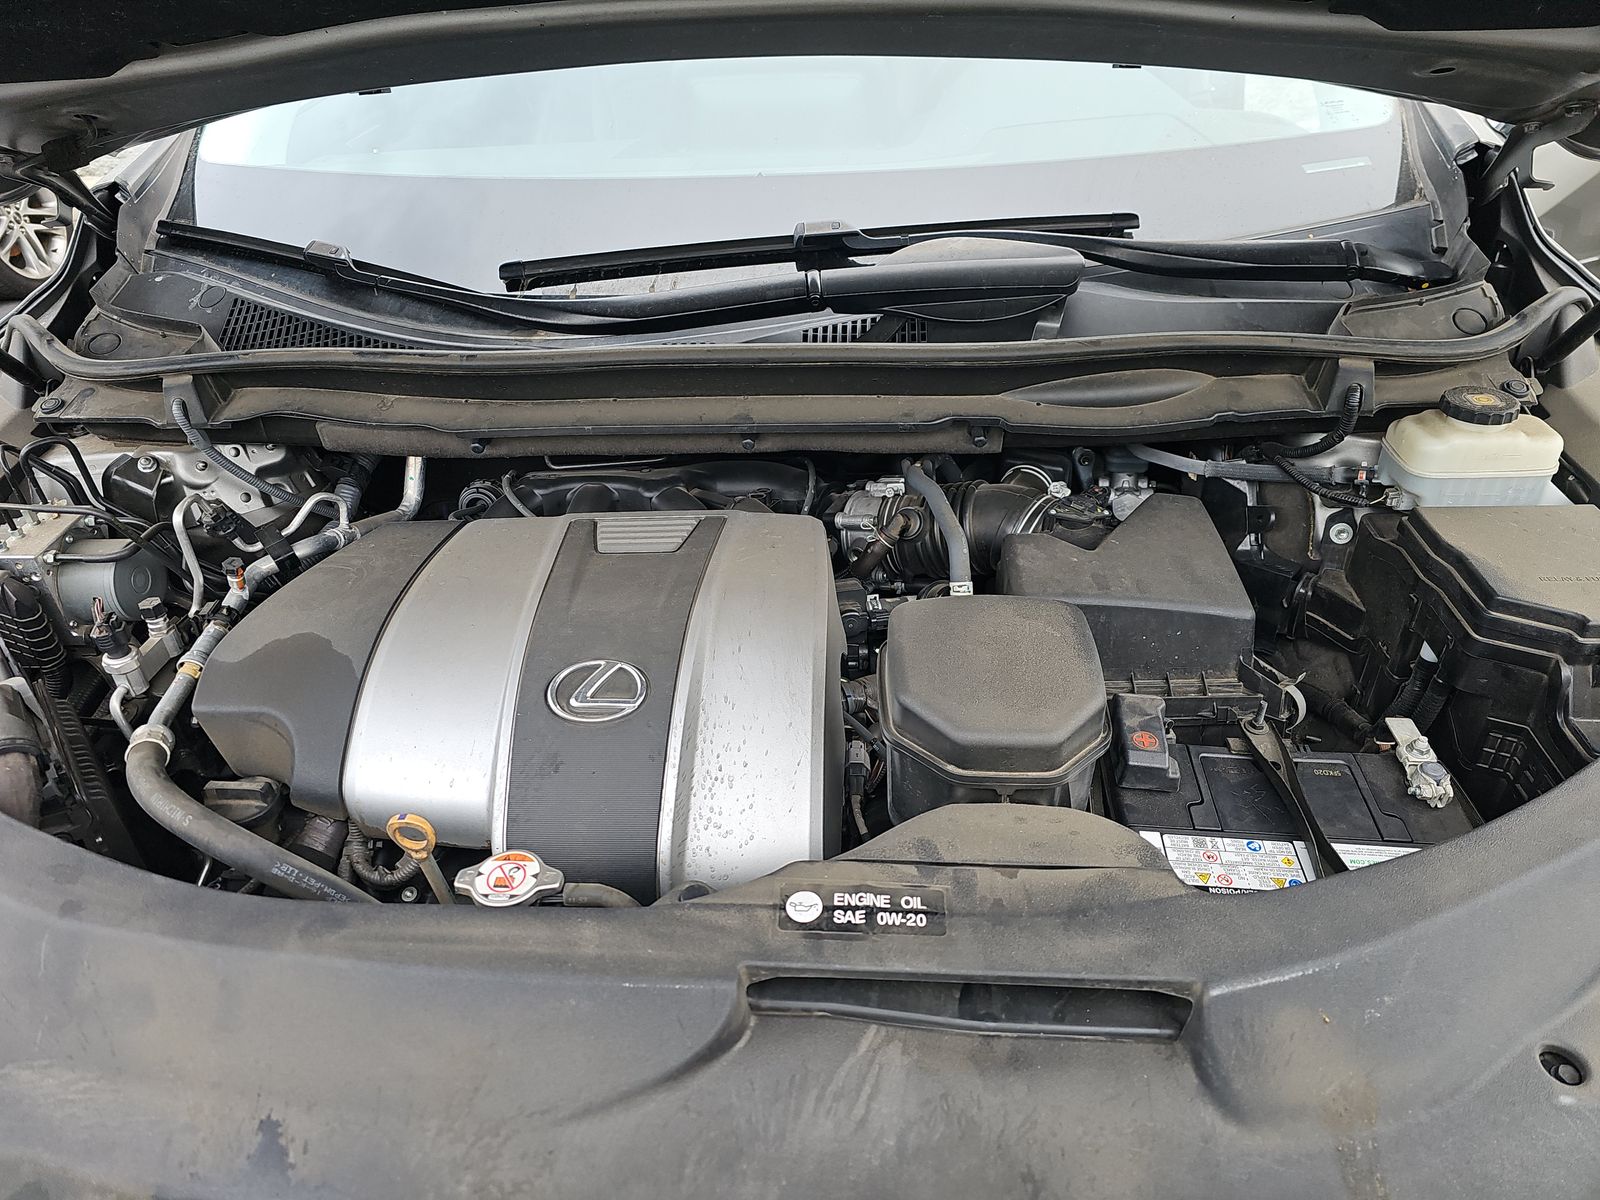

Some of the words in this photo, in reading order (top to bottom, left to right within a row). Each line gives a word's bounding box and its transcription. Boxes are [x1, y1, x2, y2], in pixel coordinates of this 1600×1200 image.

[833, 893, 891, 909] ENGINE
[901, 896, 927, 910] OIL
[833, 910, 866, 924] SAE
[876, 912, 927, 927] 0W-20
